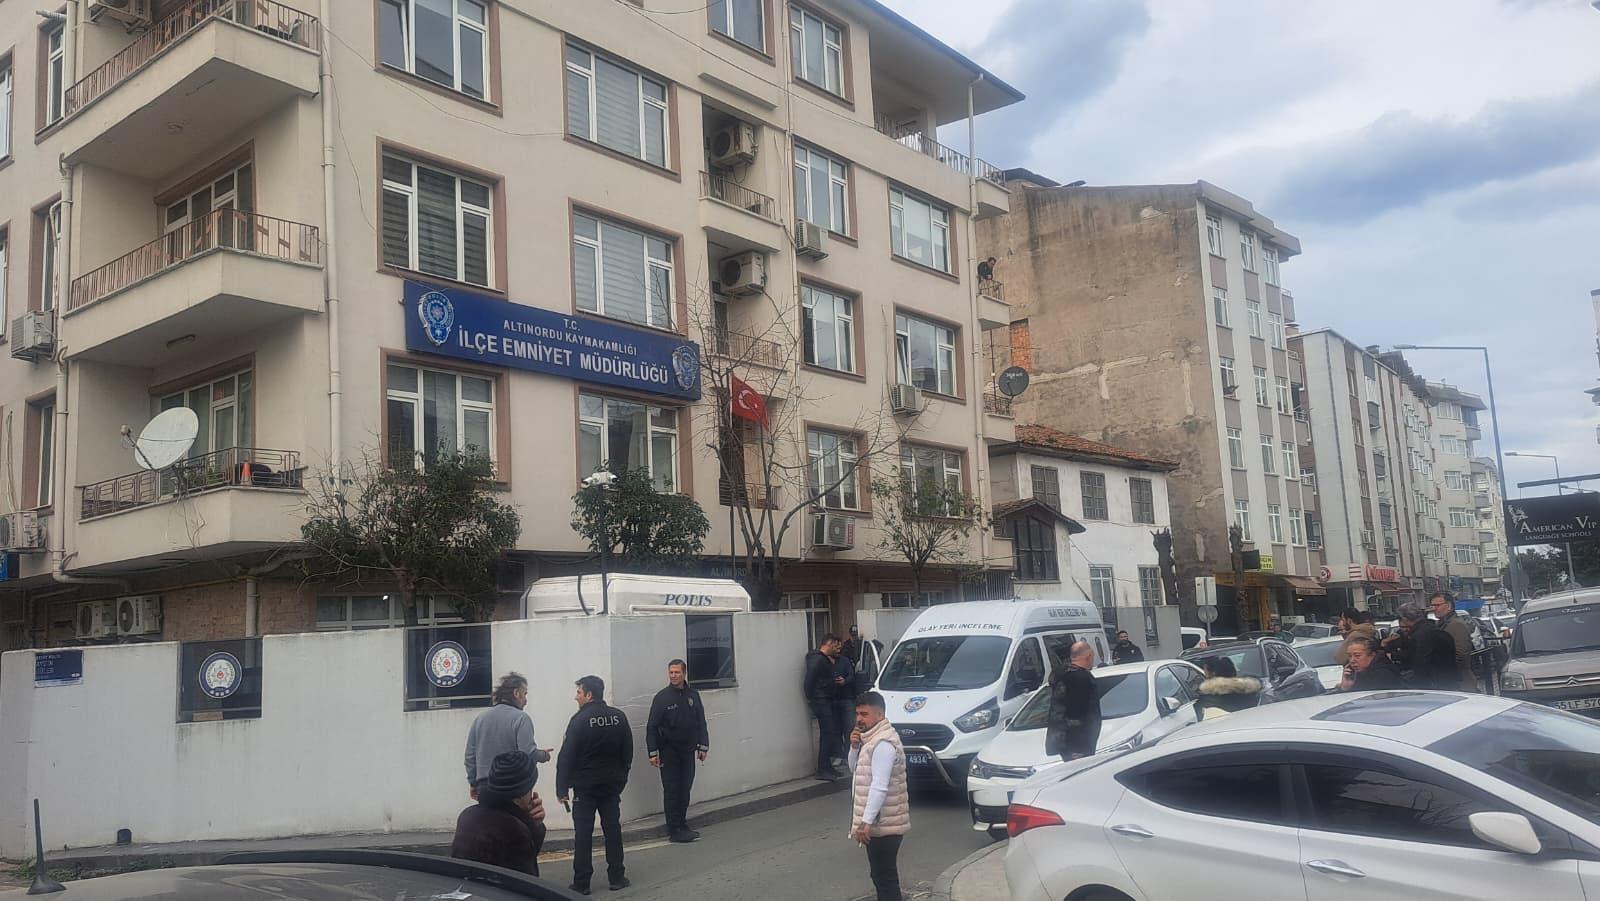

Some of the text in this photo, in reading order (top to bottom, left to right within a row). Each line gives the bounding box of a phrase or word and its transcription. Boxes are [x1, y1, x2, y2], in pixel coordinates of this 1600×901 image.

[563, 319, 581, 332] T.C.
[503, 319, 638, 357] ALTINORDU KAYMAKAMLIĞI
[458, 325, 669, 385] İLÇE EMNİYET MÜDÜRLÜĞÜ
[1519, 521, 1574, 534] AMERICAN
[1561, 531, 1593, 539] SCHOOLS
